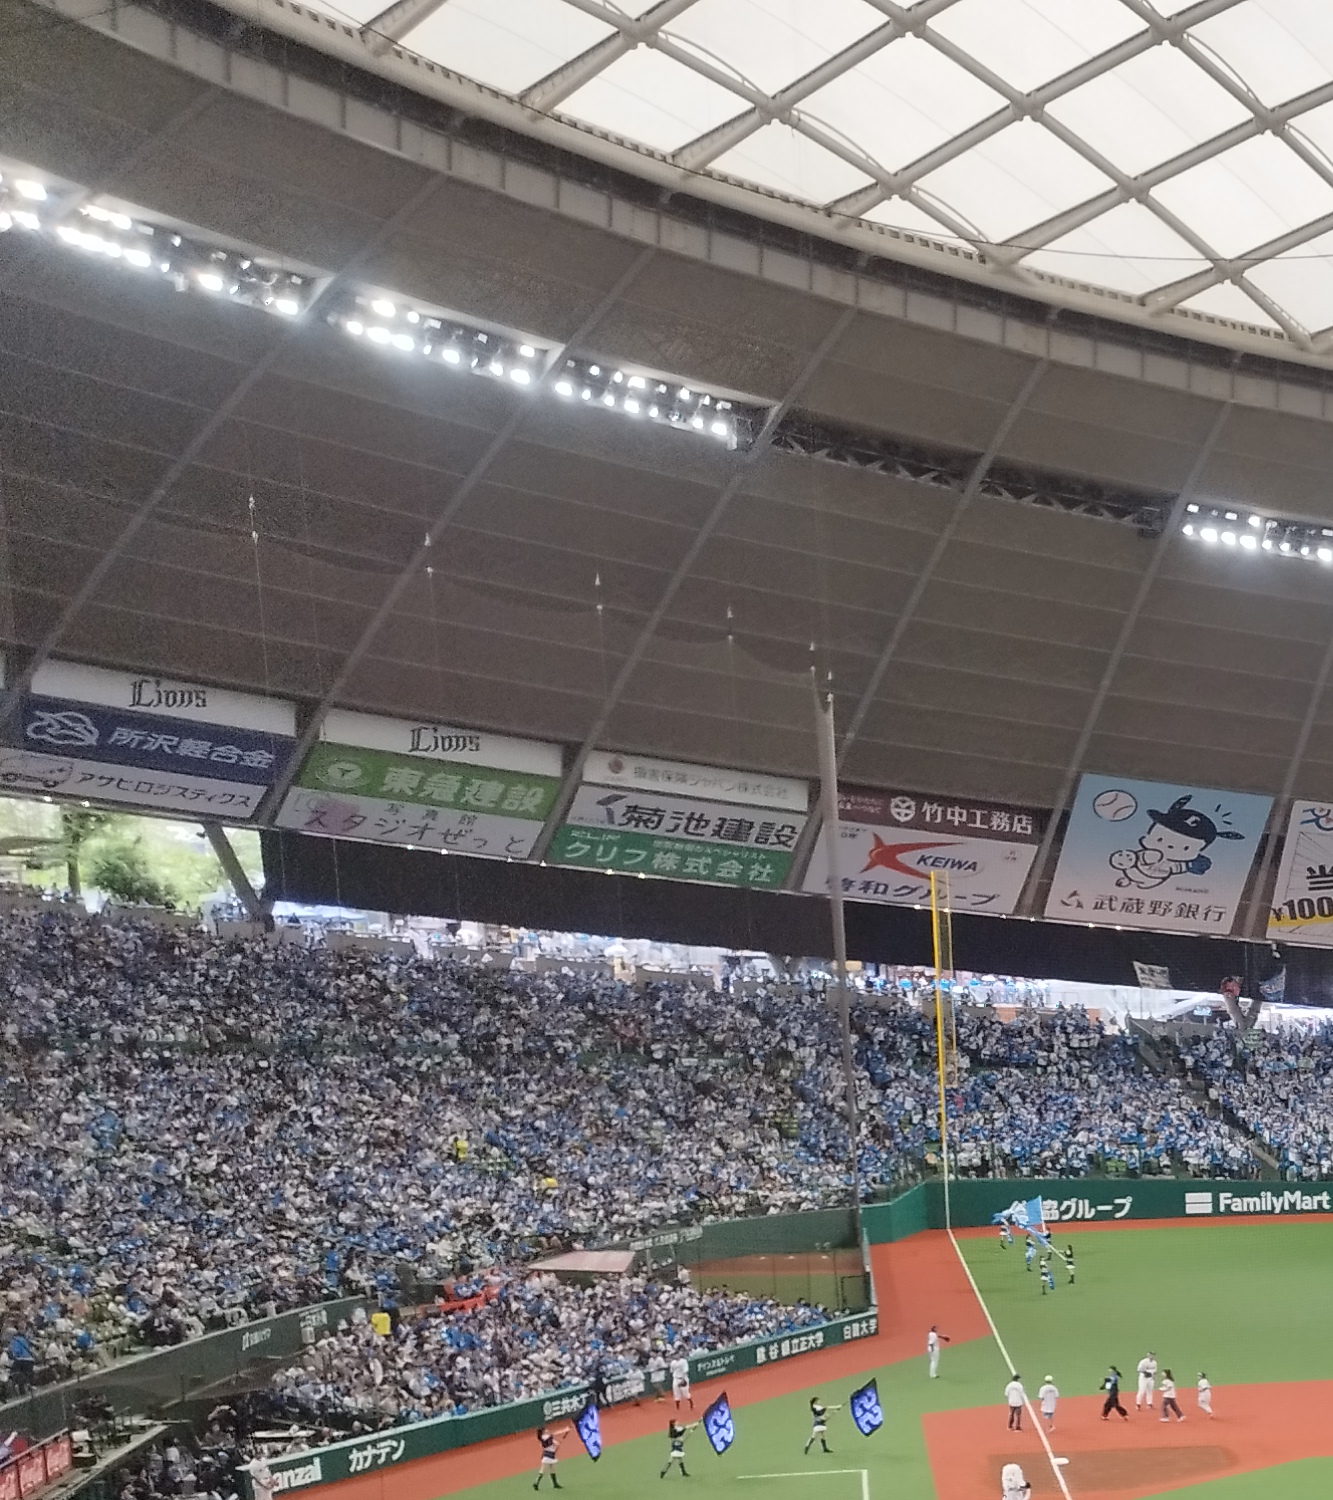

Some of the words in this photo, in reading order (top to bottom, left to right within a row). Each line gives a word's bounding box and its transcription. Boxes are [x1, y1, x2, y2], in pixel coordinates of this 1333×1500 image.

[129, 678, 207, 708] Lions
[107, 727, 275, 769] 所沢軽合金
[409, 725, 480, 753] Lions
[380, 766, 545, 814] 東急建設
[618, 804, 798, 849] 菊池建設
[921, 800, 1033, 835] 竹中工務店
[565, 841, 774, 883] クリフ株式会社
[916, 853, 978, 873] KEIWA
[1092, 894, 1228, 922] 武蔵野銀行
[1218, 1190, 1331, 1214] FamilyMart
[349, 1438, 406, 1473] カナデン
